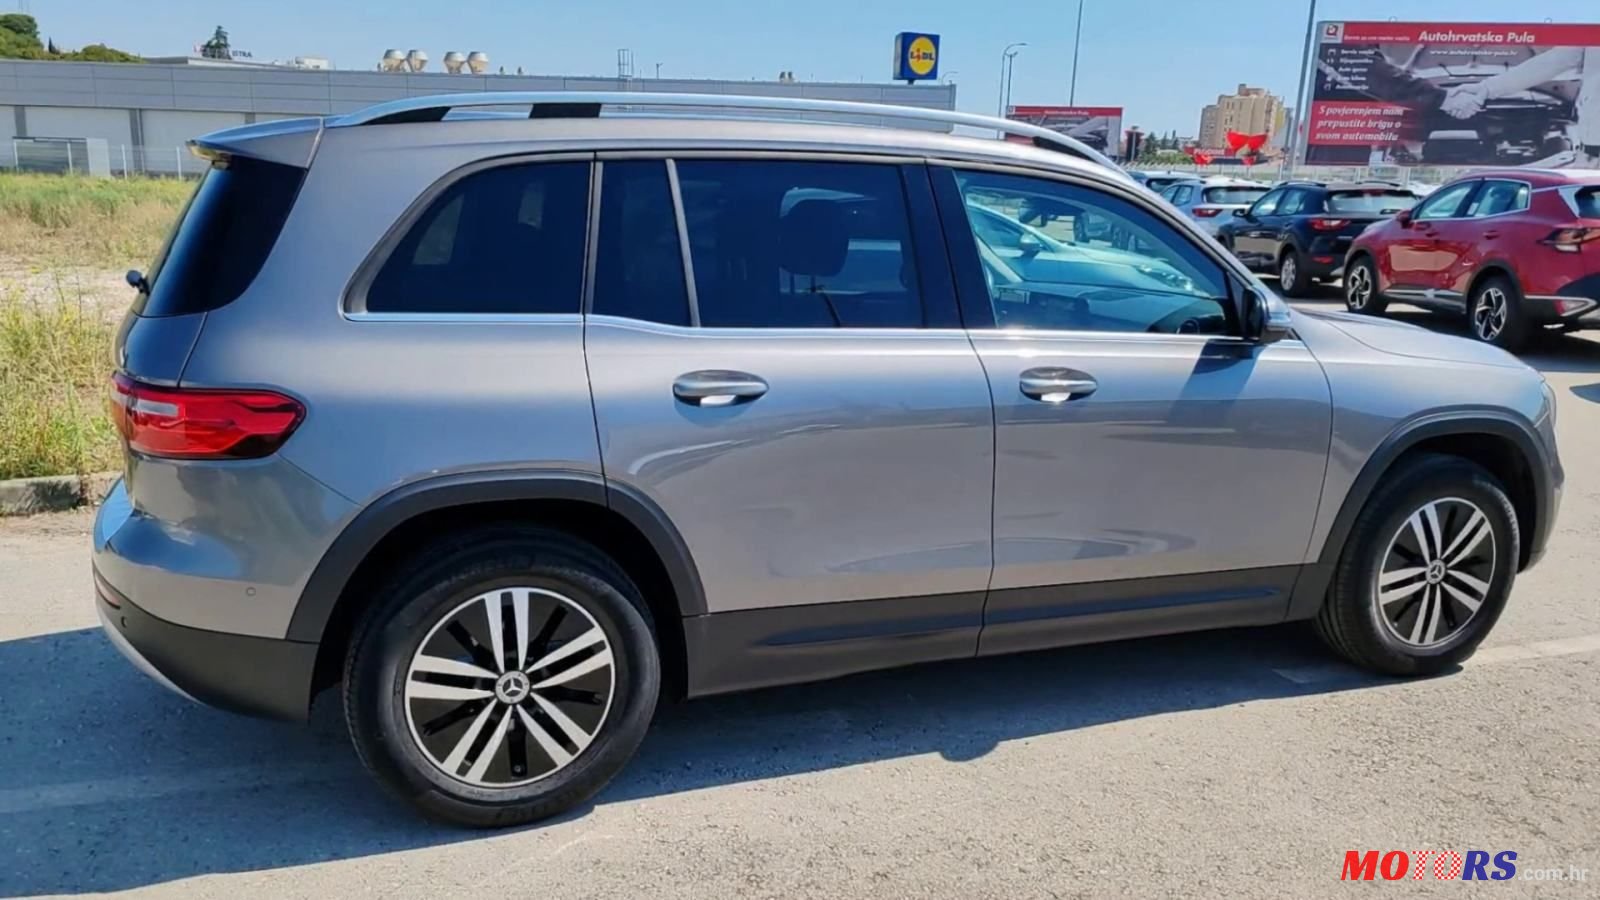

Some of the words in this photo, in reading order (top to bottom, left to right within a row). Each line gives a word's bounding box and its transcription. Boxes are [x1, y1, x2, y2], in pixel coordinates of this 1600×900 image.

[1418, 30, 1503, 43] Autohrvatska
[1507, 31, 1536, 43] Pula
[1319, 105, 1326, 115] S
[1325, 106, 1382, 117] povjerenjem
[1316, 119, 1364, 129] prepustite
[1367, 119, 1393, 130] brigu
[1394, 121, 1402, 129] o
[1315, 131, 1341, 140] svom
[1342, 131, 1399, 141] automobilu
